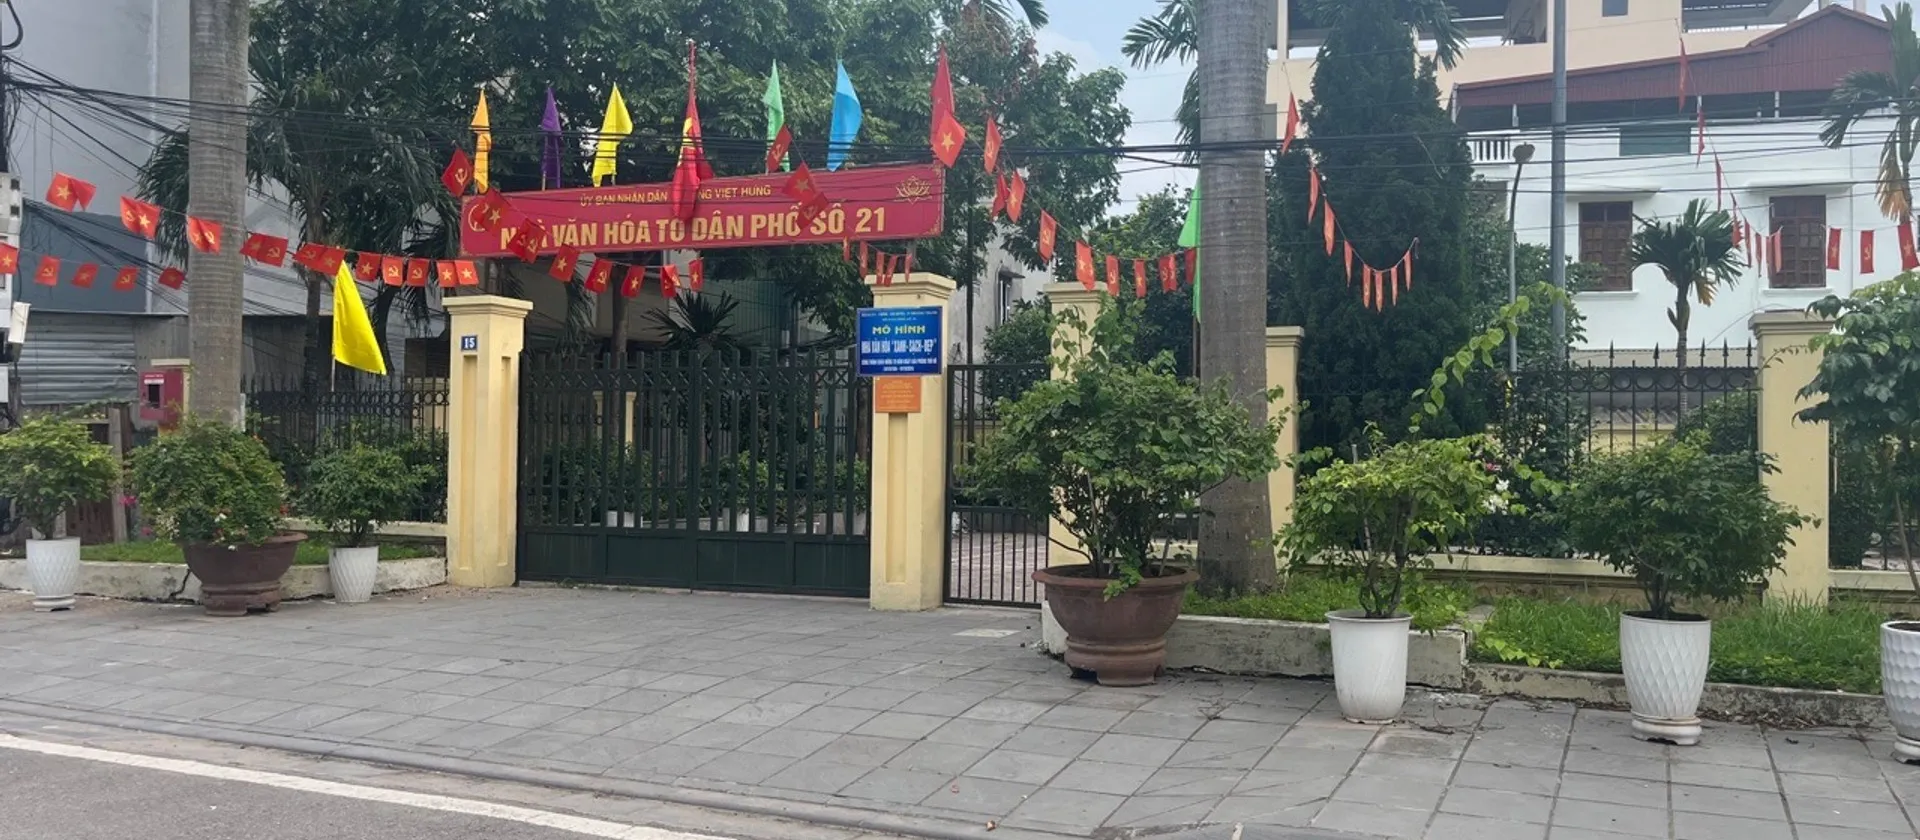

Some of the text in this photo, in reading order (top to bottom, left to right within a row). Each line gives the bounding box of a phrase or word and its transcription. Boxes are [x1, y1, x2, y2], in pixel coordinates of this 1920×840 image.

[595, 195, 615, 205] BAN
[617, 191, 645, 204] NHÂN
[647, 189, 668, 203] DÂN
[715, 187, 738, 201] VIỆT
[552, 218, 597, 248] VĂN
[604, 213, 651, 245] HÓA
[692, 210, 744, 241] DÂN
[750, 202, 803, 239] PHỐ
[855, 207, 885, 233] 21
[872, 324, 926, 334] MÔ HÌNH
[464, 337, 475, 349] 15
